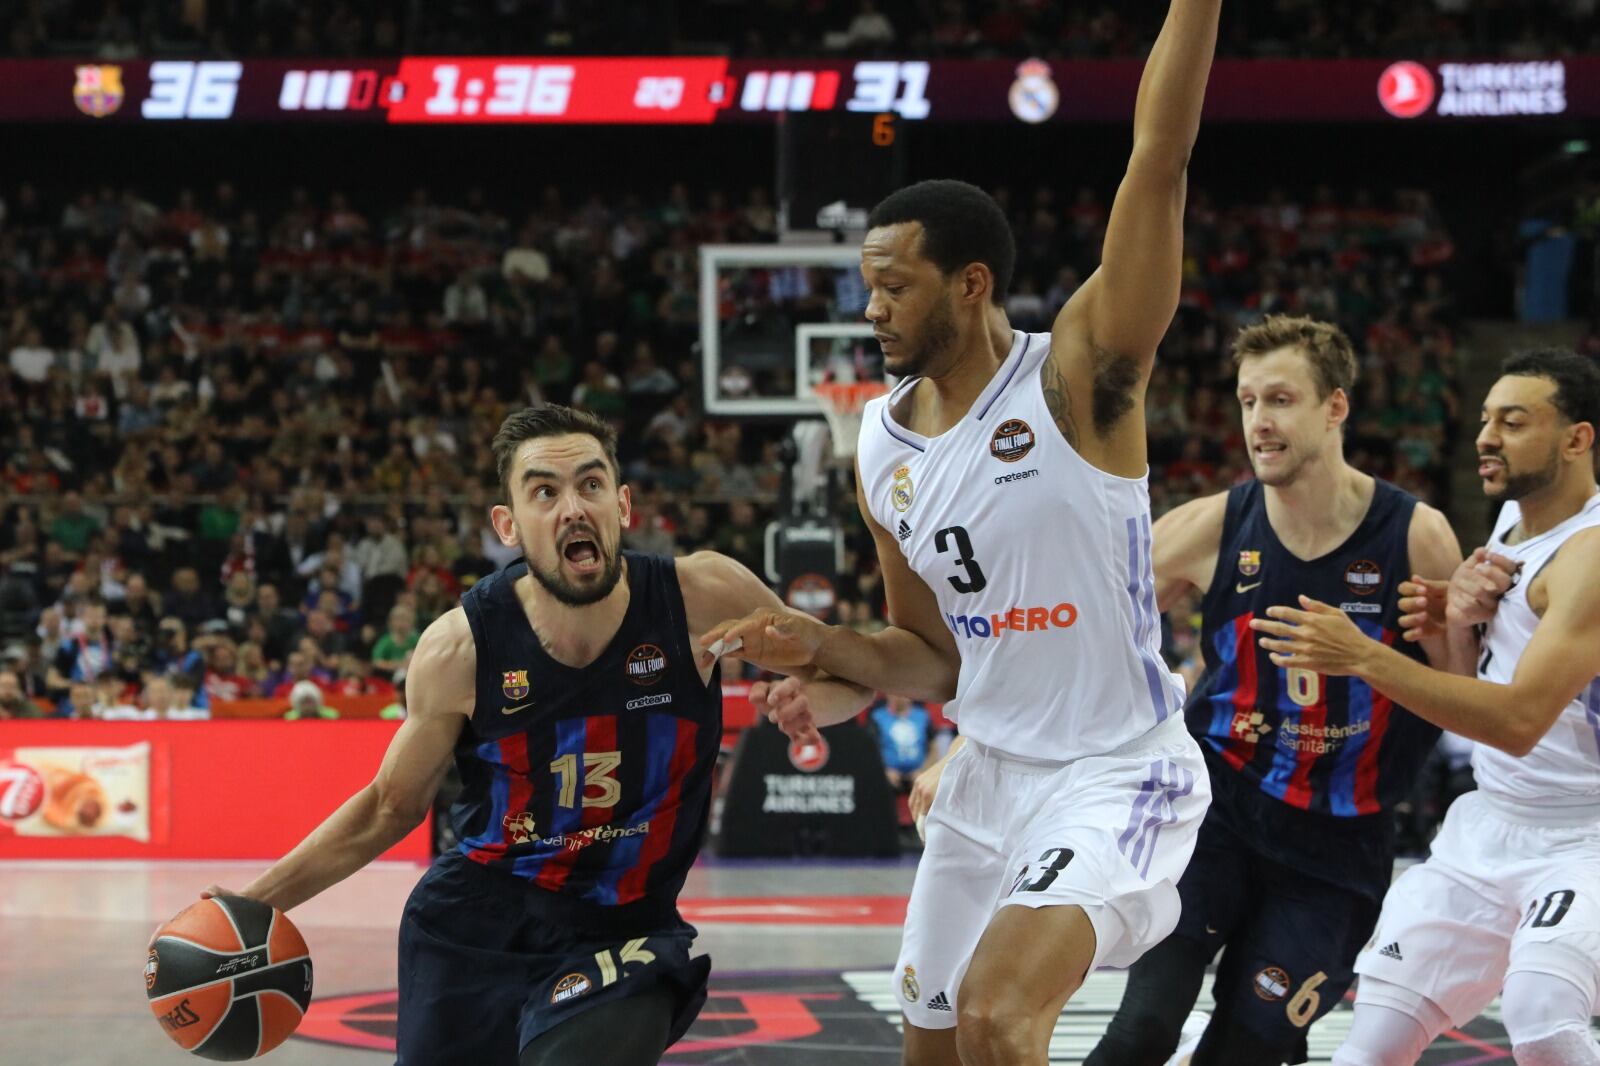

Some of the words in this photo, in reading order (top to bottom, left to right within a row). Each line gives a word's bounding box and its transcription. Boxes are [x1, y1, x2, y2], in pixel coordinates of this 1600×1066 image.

[141, 61, 243, 119] 36
[425, 65, 575, 115] 1:36
[846, 61, 931, 119] 31
[1438, 61, 1565, 91] TURKISH
[1437, 89, 1567, 116] AIRLINES
[994, 435, 1014, 451] FINAL
[1013, 432, 1031, 448] FOUR
[994, 469, 1039, 485] oneteam
[934, 525, 987, 594] 3
[629, 660, 648, 675] FINAL
[647, 657, 665, 673] FOUR
[626, 693, 672, 710] oneteam
[550, 751, 622, 809] 13
[763, 774, 854, 794] TURKISH
[762, 793, 856, 814] AIRLINES
[1286, 970, 1328, 1028] 6
